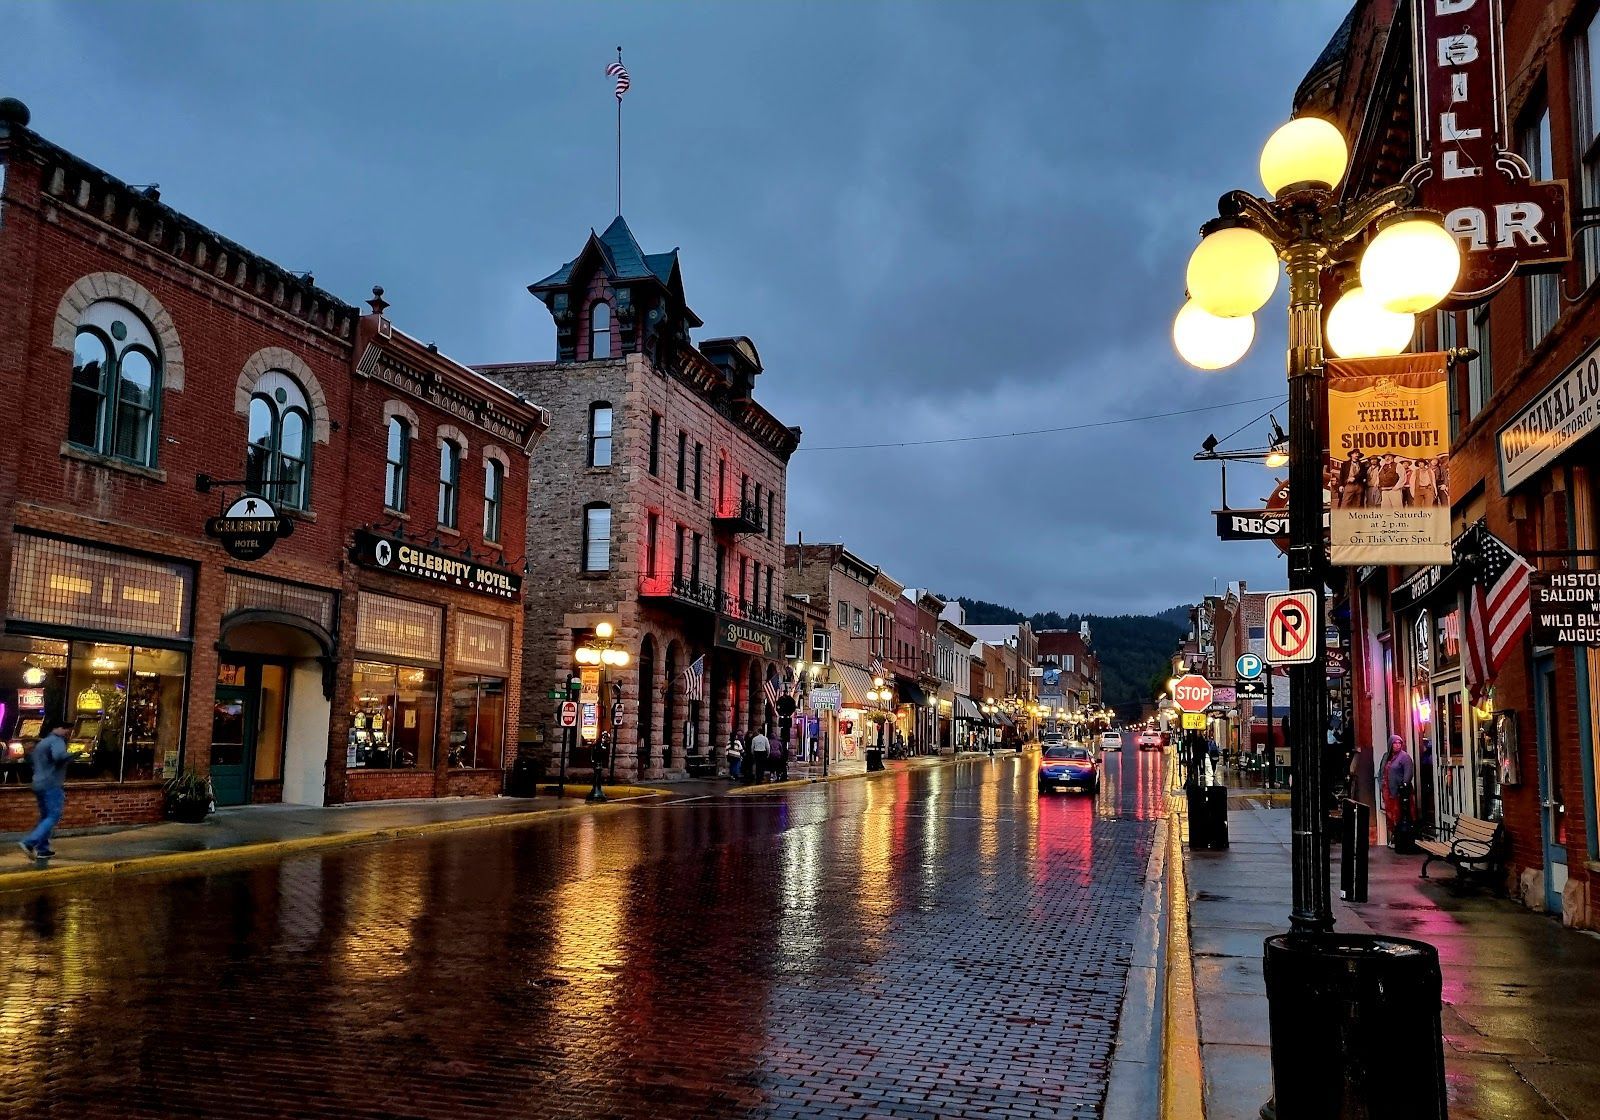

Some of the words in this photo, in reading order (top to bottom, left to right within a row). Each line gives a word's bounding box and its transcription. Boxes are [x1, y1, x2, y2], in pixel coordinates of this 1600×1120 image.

[1436, 34, 1483, 180] BILL
[1443, 202, 1549, 251] AR
[1357, 407, 1419, 422] THRILL
[1504, 379, 1575, 464] ORIGINAL
[1371, 423, 1396, 431] MAIN
[1397, 421, 1431, 430] STREET
[1551, 405, 1593, 450] HISTORIC
[1341, 430, 1439, 449] SHOOTOUT!
[1348, 511, 1384, 520] Monday
[1393, 510, 1433, 520] Saturday
[214, 519, 281, 533] CELEBRITY
[1381, 520, 1387, 528] 2
[1389, 521, 1409, 529] p.m.
[234, 539, 260, 548] HOTEL
[1349, 535, 1364, 544] On
[1366, 535, 1386, 544] This
[1388, 535, 1409, 544] Very
[1411, 534, 1432, 544] Spot
[398, 545, 472, 579] CELEBRITY
[476, 568, 512, 590] HOTEL
[399, 563, 448, 582] MUSEUM
[469, 581, 512, 598] GAMING
[1551, 573, 1600, 587] HISTO
[1540, 588, 1595, 602] SALOON
[1540, 614, 1573, 627] WILD
[727, 623, 772, 653] BULLOCK
[1242, 657, 1258, 676] P
[1176, 686, 1210, 701] STOP
[1236, 692, 1249, 700] Public
[1249, 692, 1264, 700] Parking
